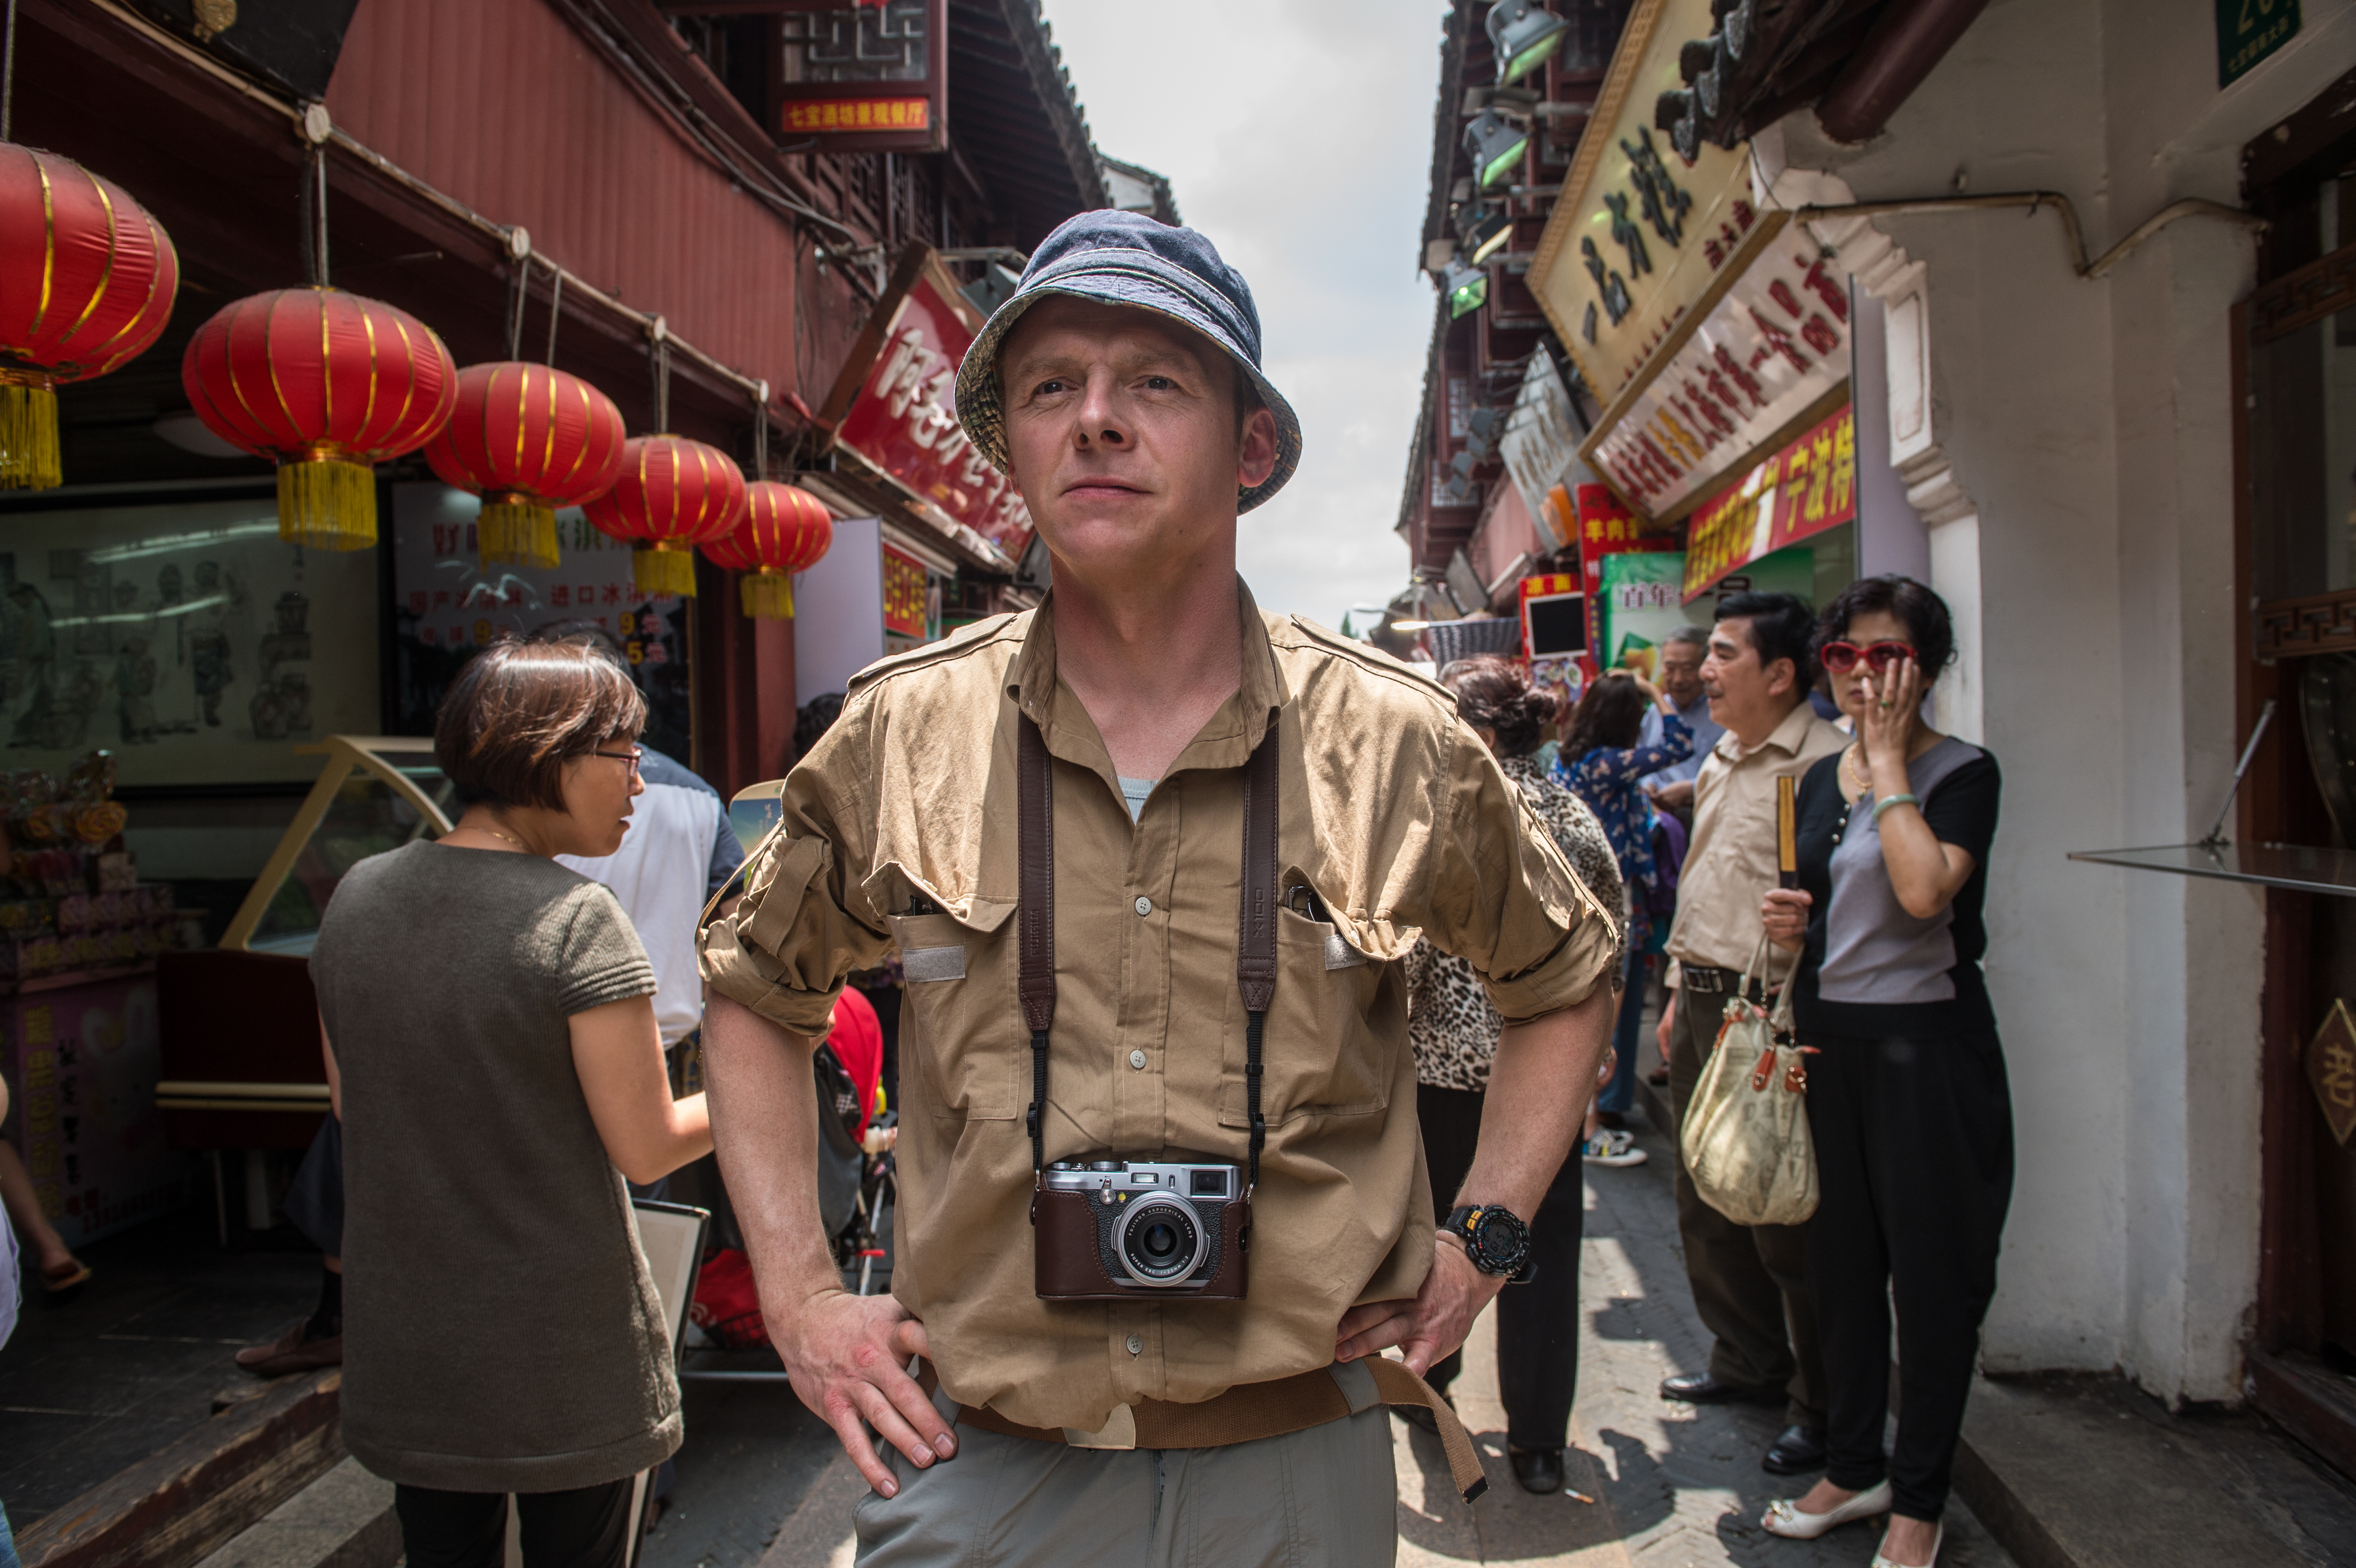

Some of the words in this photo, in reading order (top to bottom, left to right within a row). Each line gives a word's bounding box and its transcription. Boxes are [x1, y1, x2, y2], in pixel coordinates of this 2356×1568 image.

[1129, 1213, 1145, 1236] FUJINON
[1148, 1208, 1184, 1221] ASPHERICAL
[1185, 1223, 1193, 1238] LENS
[1131, 1253, 1144, 1268] SUPER
